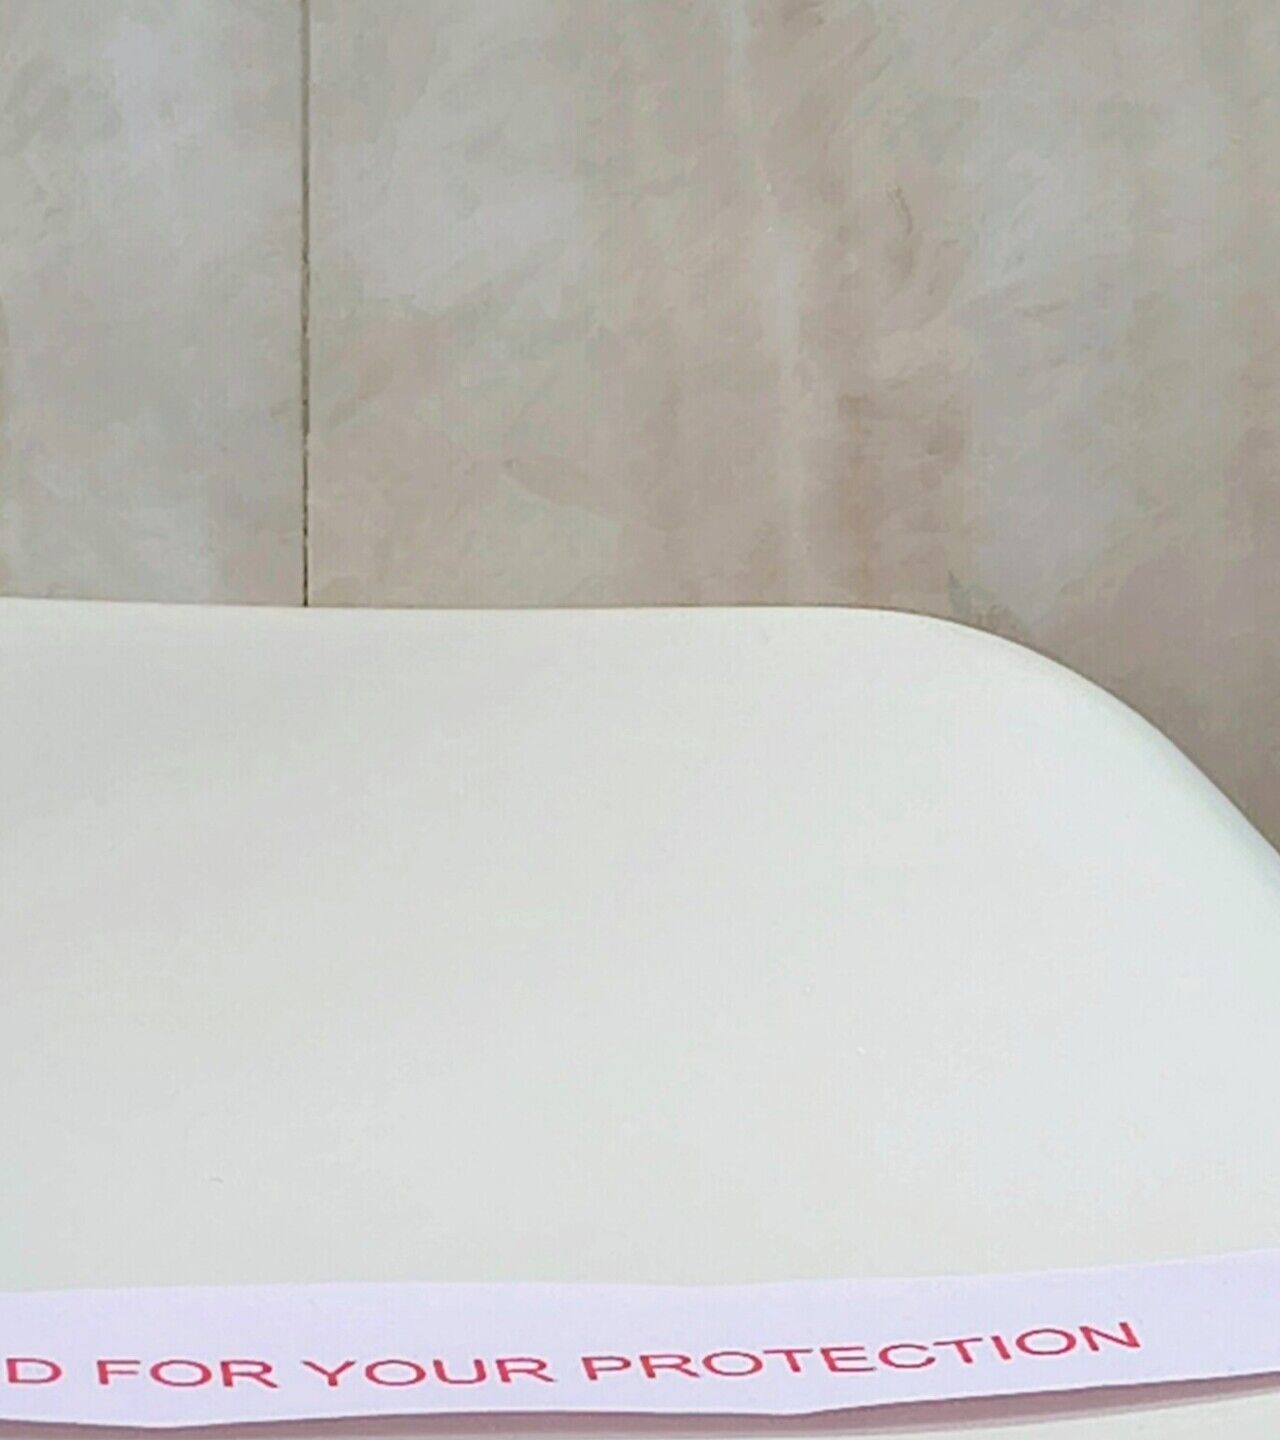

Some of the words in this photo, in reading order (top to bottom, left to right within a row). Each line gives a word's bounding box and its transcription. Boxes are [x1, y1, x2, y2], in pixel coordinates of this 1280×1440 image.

[96, 1358, 280, 1389] FOR
[302, 1357, 554, 1389] YOUR
[581, 1321, 1141, 1383] PROTECTION
